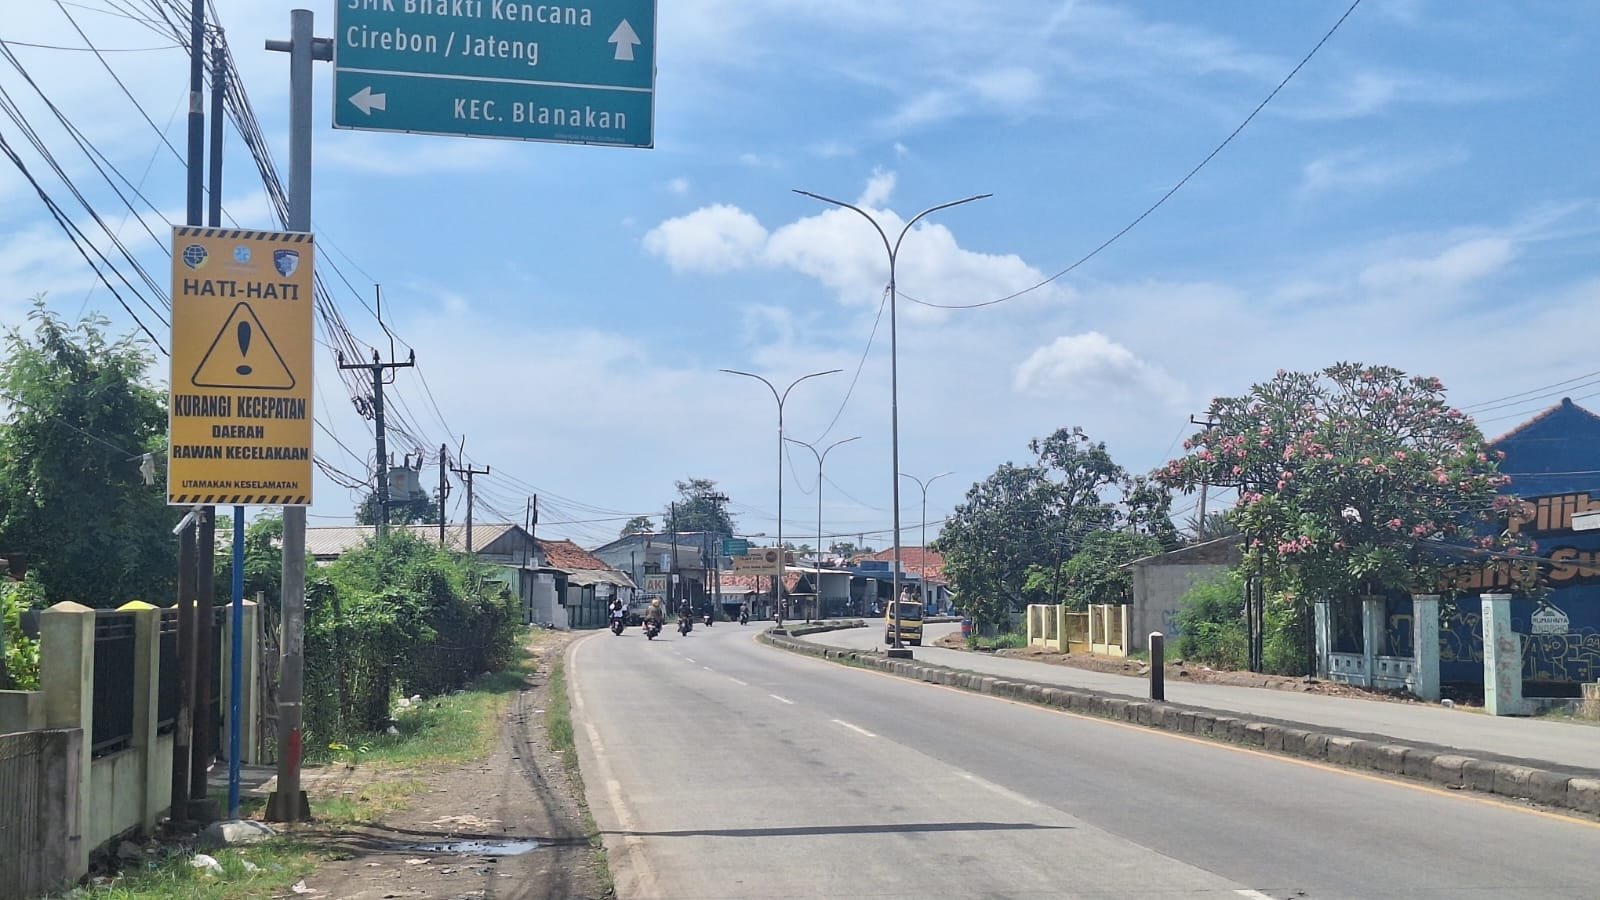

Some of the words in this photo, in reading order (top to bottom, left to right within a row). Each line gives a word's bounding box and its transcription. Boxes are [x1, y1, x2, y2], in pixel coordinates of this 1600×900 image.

[404, 0, 482, 18] Bhakti
[492, 0, 592, 26] Kencana
[346, 25, 437, 53] Cirebon
[444, 31, 455, 57] /
[462, 34, 539, 66] Jateng
[454, 98, 503, 122] KEC.
[512, 102, 627, 130] Blanakan
[183, 278, 299, 300] HATI-HATI
[174, 394, 231, 418] KURANGI
[237, 396, 306, 420] KECEPATAN
[212, 425, 264, 439] DAERAH
[173, 445, 223, 459] RAWAN
[226, 446, 308, 461] KECELAKAAN
[182, 480, 232, 489] UTAMAKAN
[234, 480, 298, 490] KESELAMATAN
